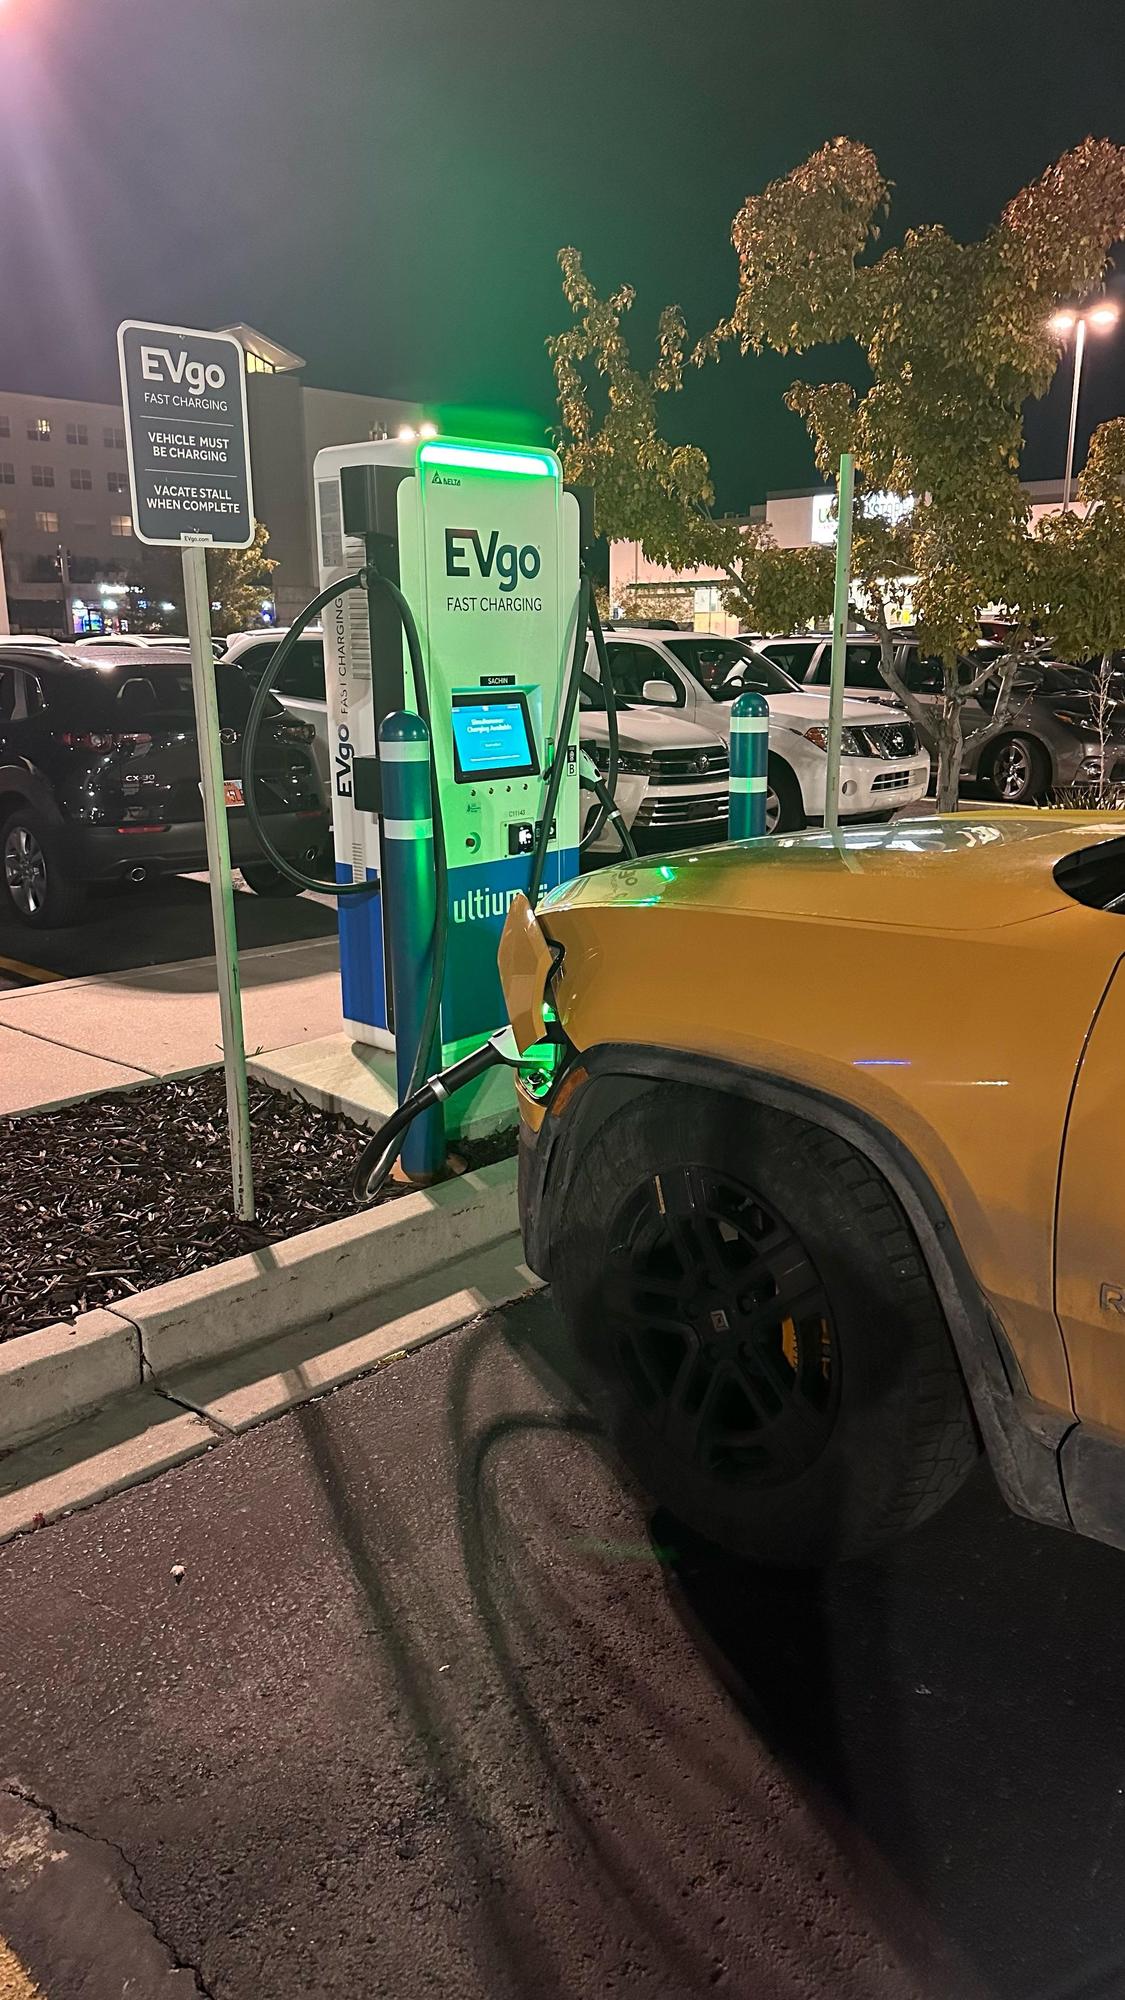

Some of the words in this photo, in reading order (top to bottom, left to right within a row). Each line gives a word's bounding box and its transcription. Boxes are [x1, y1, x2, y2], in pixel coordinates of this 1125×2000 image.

[140, 345, 226, 395] EVgo
[144, 392, 170, 405] FAST
[172, 396, 228, 412] CHARGING
[148, 431, 196, 447] VEHICLE
[200, 436, 230, 449] MUST
[153, 446, 167, 458] BE
[169, 447, 227, 462] CHARGING
[153, 484, 198, 498] VACATE
[199, 488, 232, 500] STALL
[146, 498, 181, 511] WHEN
[183, 499, 241, 514] COMPLETE
[183, 535, 210, 543] EVgo.com
[444, 527, 541, 593] EVgo
[447, 597, 477, 612] FAST
[480, 597, 542, 612] CHARGING
[335, 597, 347, 677] CHARGING
[488, 676, 509, 686] SACHIN
[339, 682, 348, 714] FAST
[335, 723, 354, 798] EVgo
[569, 763, 575, 774] B
[125, 774, 155, 782] CX-30
